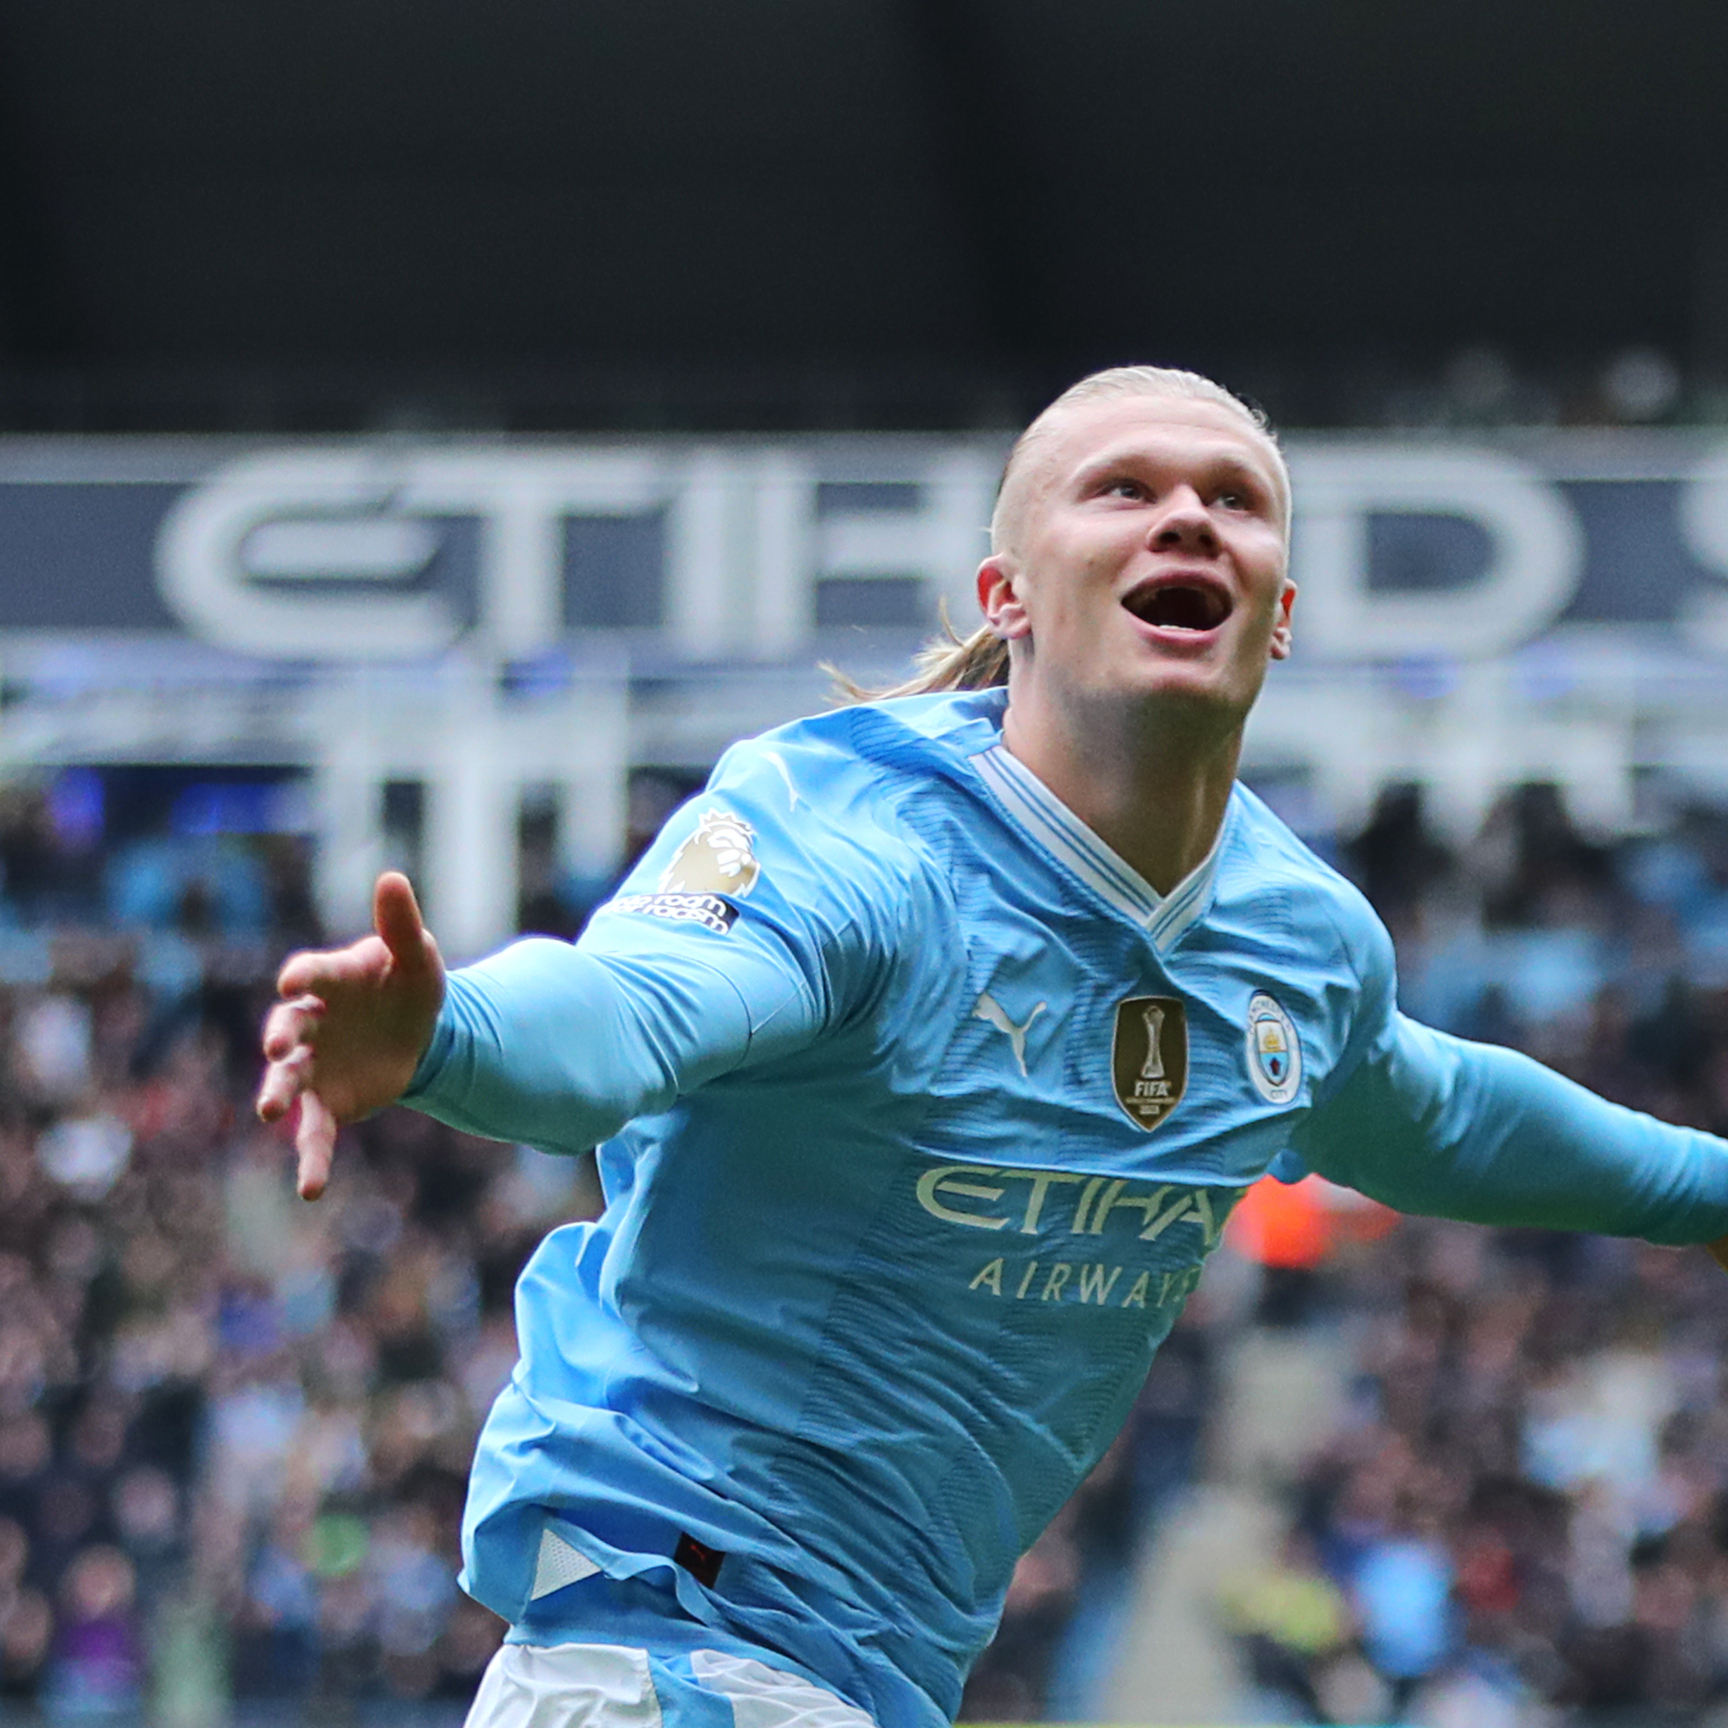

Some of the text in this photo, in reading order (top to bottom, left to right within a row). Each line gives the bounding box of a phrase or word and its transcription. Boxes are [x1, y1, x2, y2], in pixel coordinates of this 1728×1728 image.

[155, 447, 1584, 662] ETIHD
[1134, 1081, 1169, 1097] FIFA
[916, 1165, 1232, 1247] ETIHA
